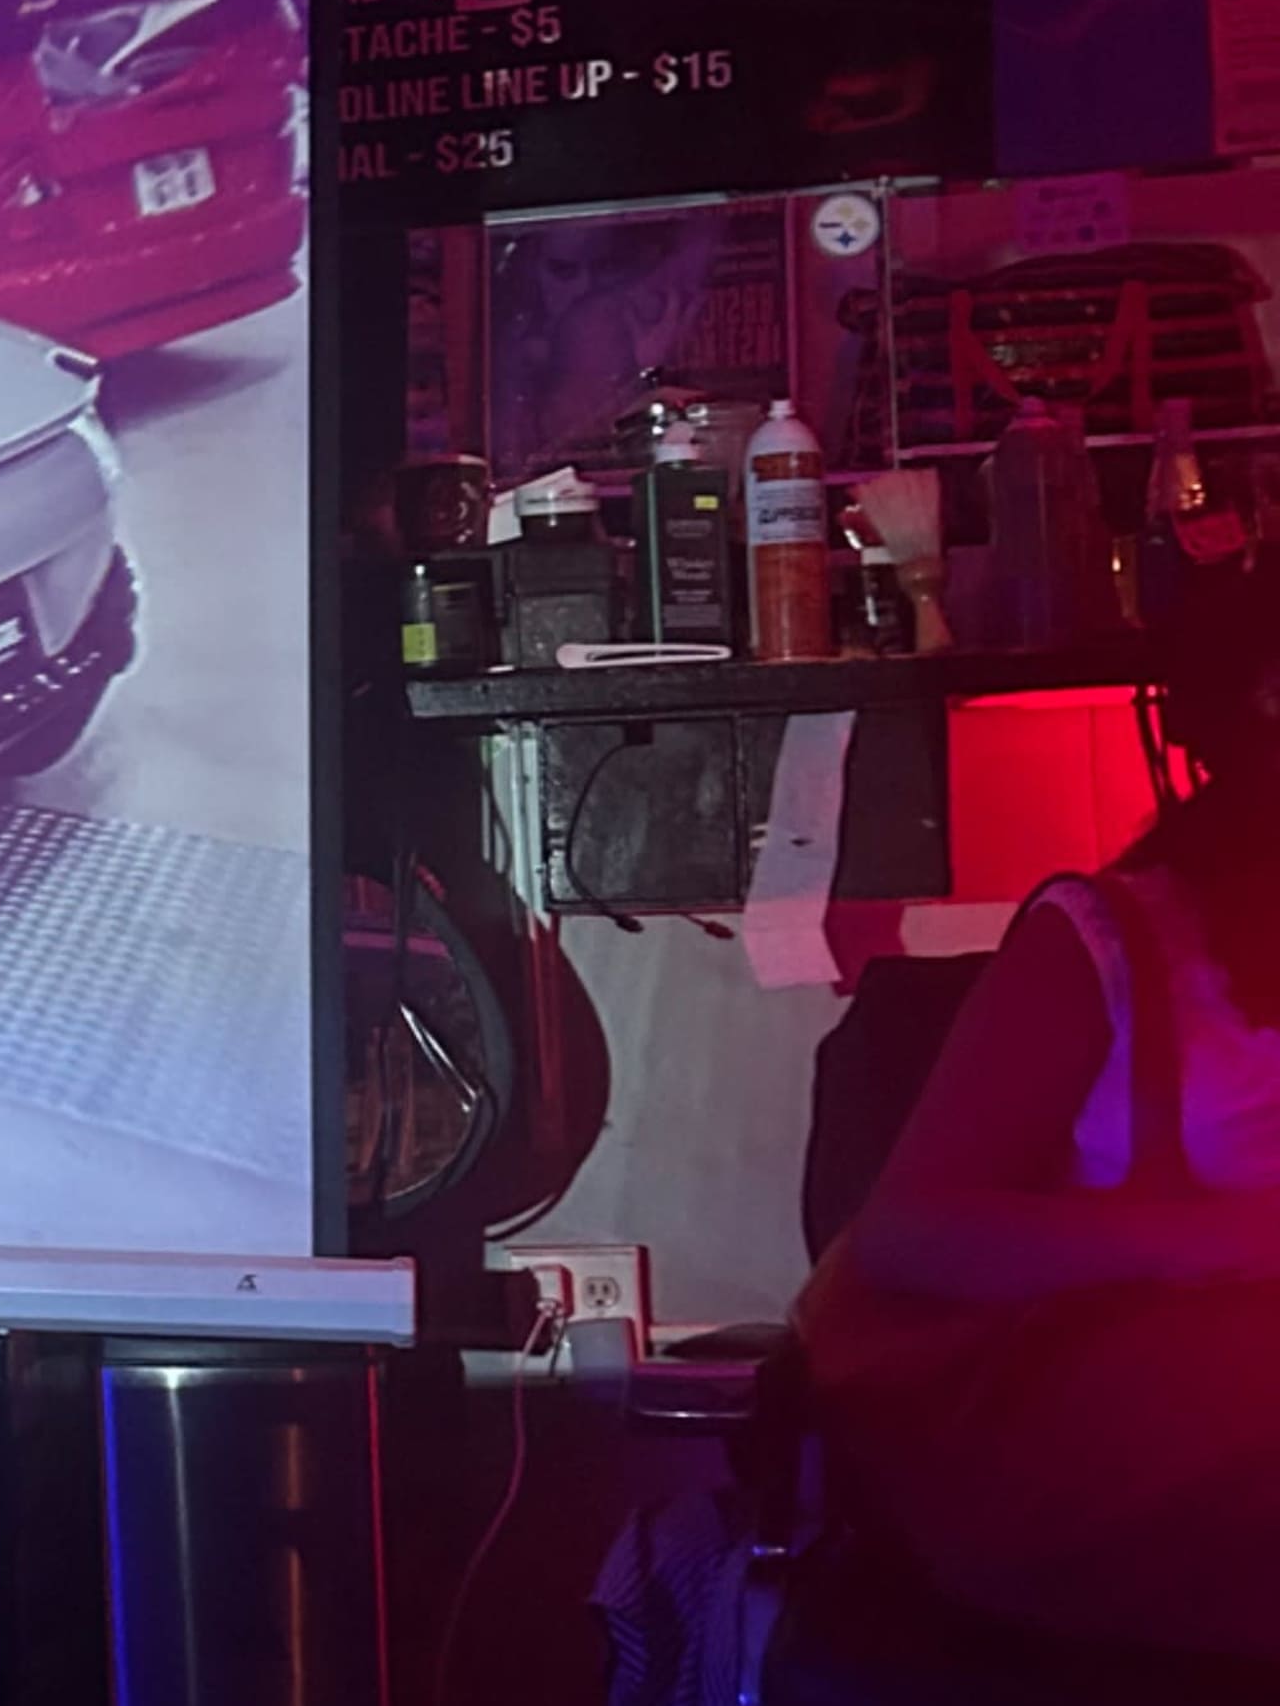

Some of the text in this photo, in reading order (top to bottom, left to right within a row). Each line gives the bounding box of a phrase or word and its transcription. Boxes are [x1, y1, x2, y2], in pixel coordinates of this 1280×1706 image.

[344, 14, 470, 63] TACHE
[509, 6, 563, 48] $5
[460, 66, 550, 112] LINE
[559, 59, 614, 101] UP
[651, 50, 734, 94] $15
[435, 130, 516, 173] $25
